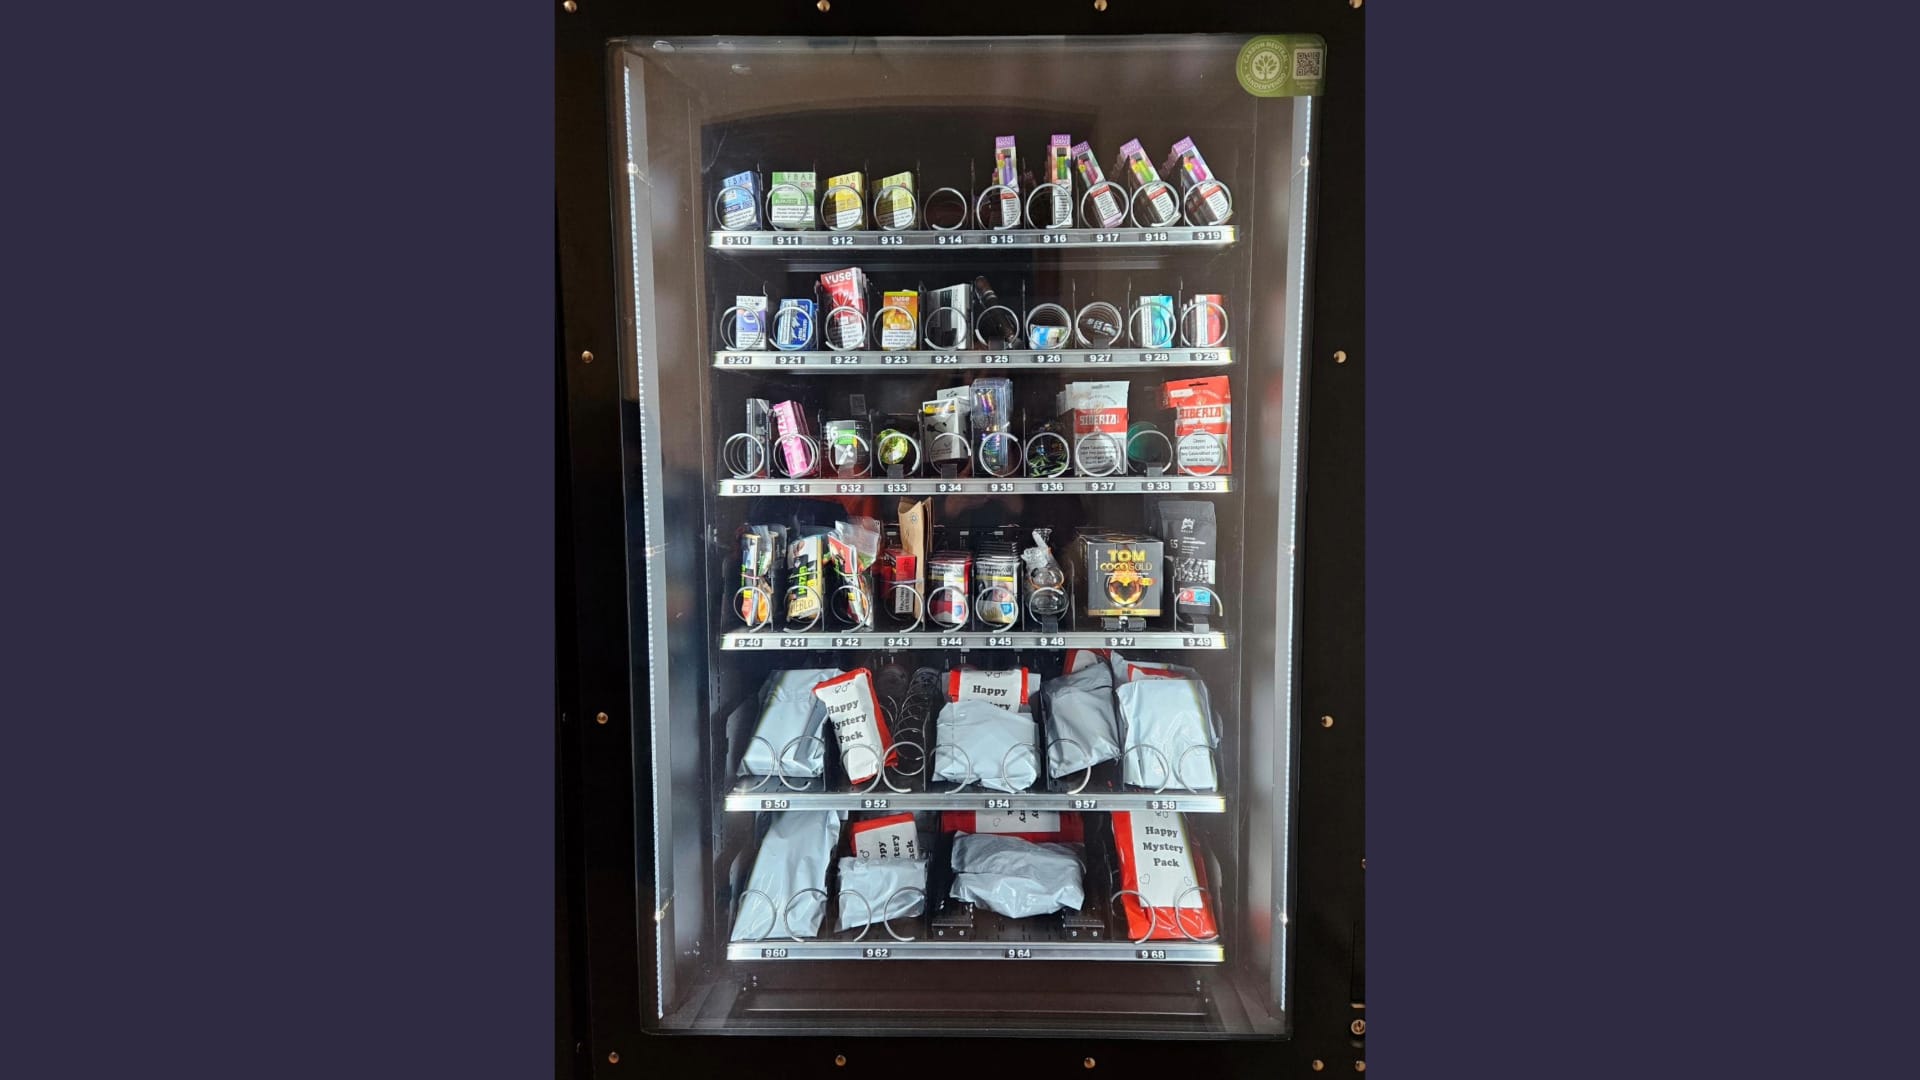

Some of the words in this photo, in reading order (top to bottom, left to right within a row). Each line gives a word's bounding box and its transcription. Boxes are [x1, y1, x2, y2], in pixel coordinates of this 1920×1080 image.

[1107, 549, 1146, 562] TOM
[972, 685, 1008, 697] Happy
[827, 699, 859, 715] Happy
[838, 731, 864, 744] Pack
[1145, 826, 1179, 838] Happy
[906, 839, 916, 860] ack
[1142, 842, 1184, 854] Mystery
[1153, 857, 1180, 867] Pack
